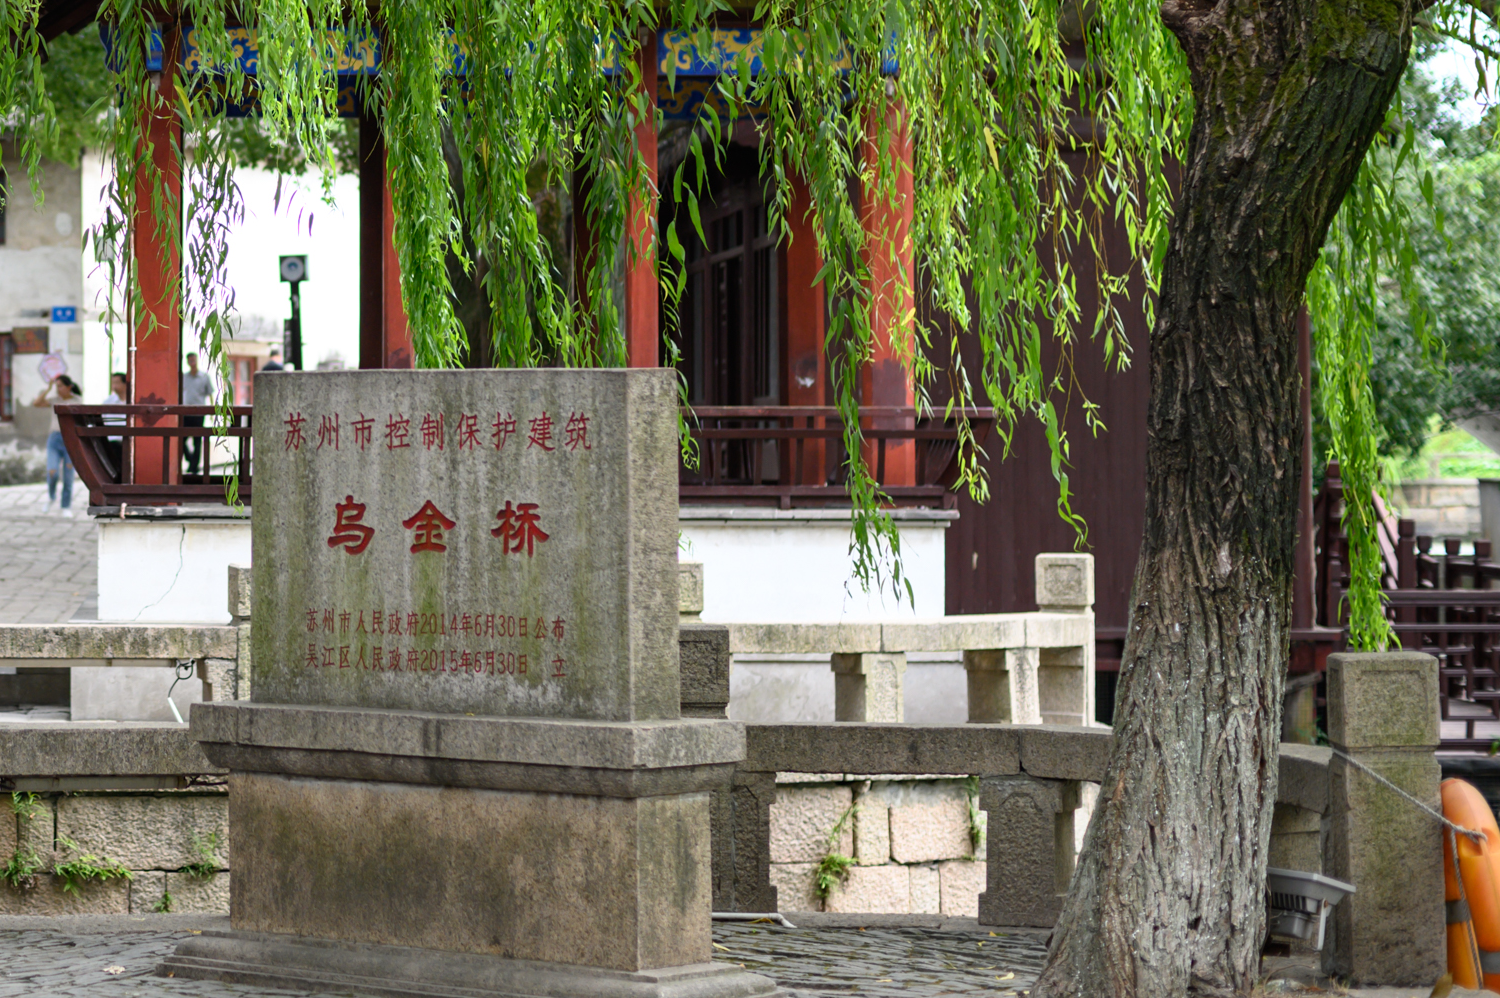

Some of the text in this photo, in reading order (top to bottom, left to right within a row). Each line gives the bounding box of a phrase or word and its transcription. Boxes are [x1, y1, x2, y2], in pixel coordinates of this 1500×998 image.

[283, 411, 592, 452] 苏州市控制保护建筑
[327, 495, 550, 557] 乌金桥
[306, 608, 566, 642] 苏州市人民政府2014年6月30日公布
[305, 643, 566, 678] 吴江区人民政府2015年6月30日 立
